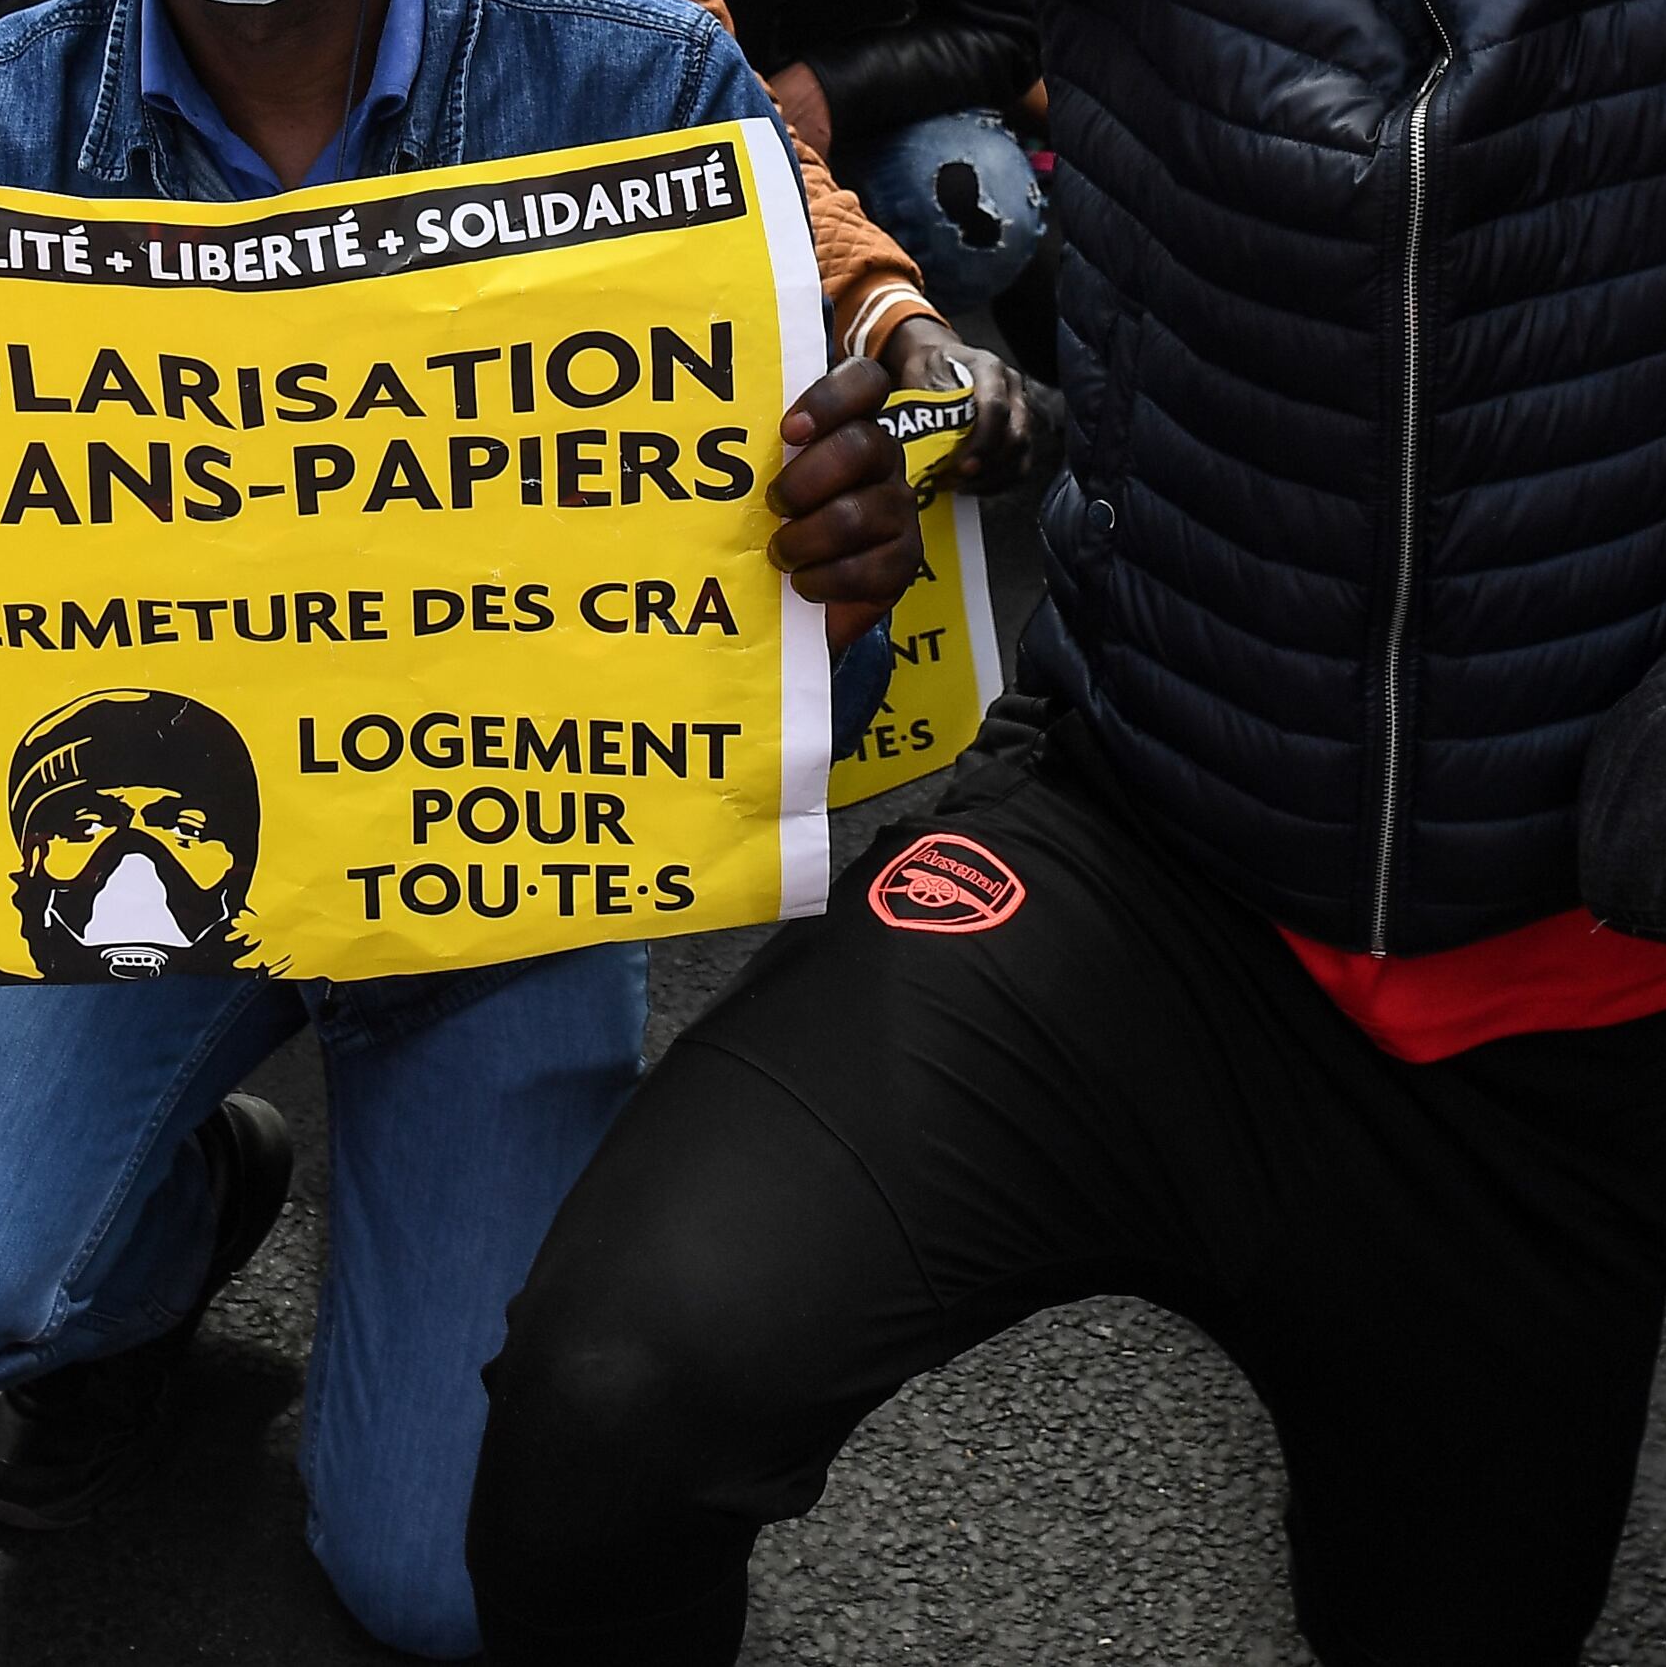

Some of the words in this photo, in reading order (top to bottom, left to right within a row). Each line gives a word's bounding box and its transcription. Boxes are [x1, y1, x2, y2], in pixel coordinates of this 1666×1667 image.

[148, 210, 363, 285] LIBERTÉ
[417, 149, 735, 255] SOLIDARITÉ
[411, 583, 555, 637] DES
[580, 578, 739, 637] CRA
[297, 713, 741, 778] LOGEMENT
[411, 788, 632, 846] POUR
[913, 846, 1004, 896] Arsenal
